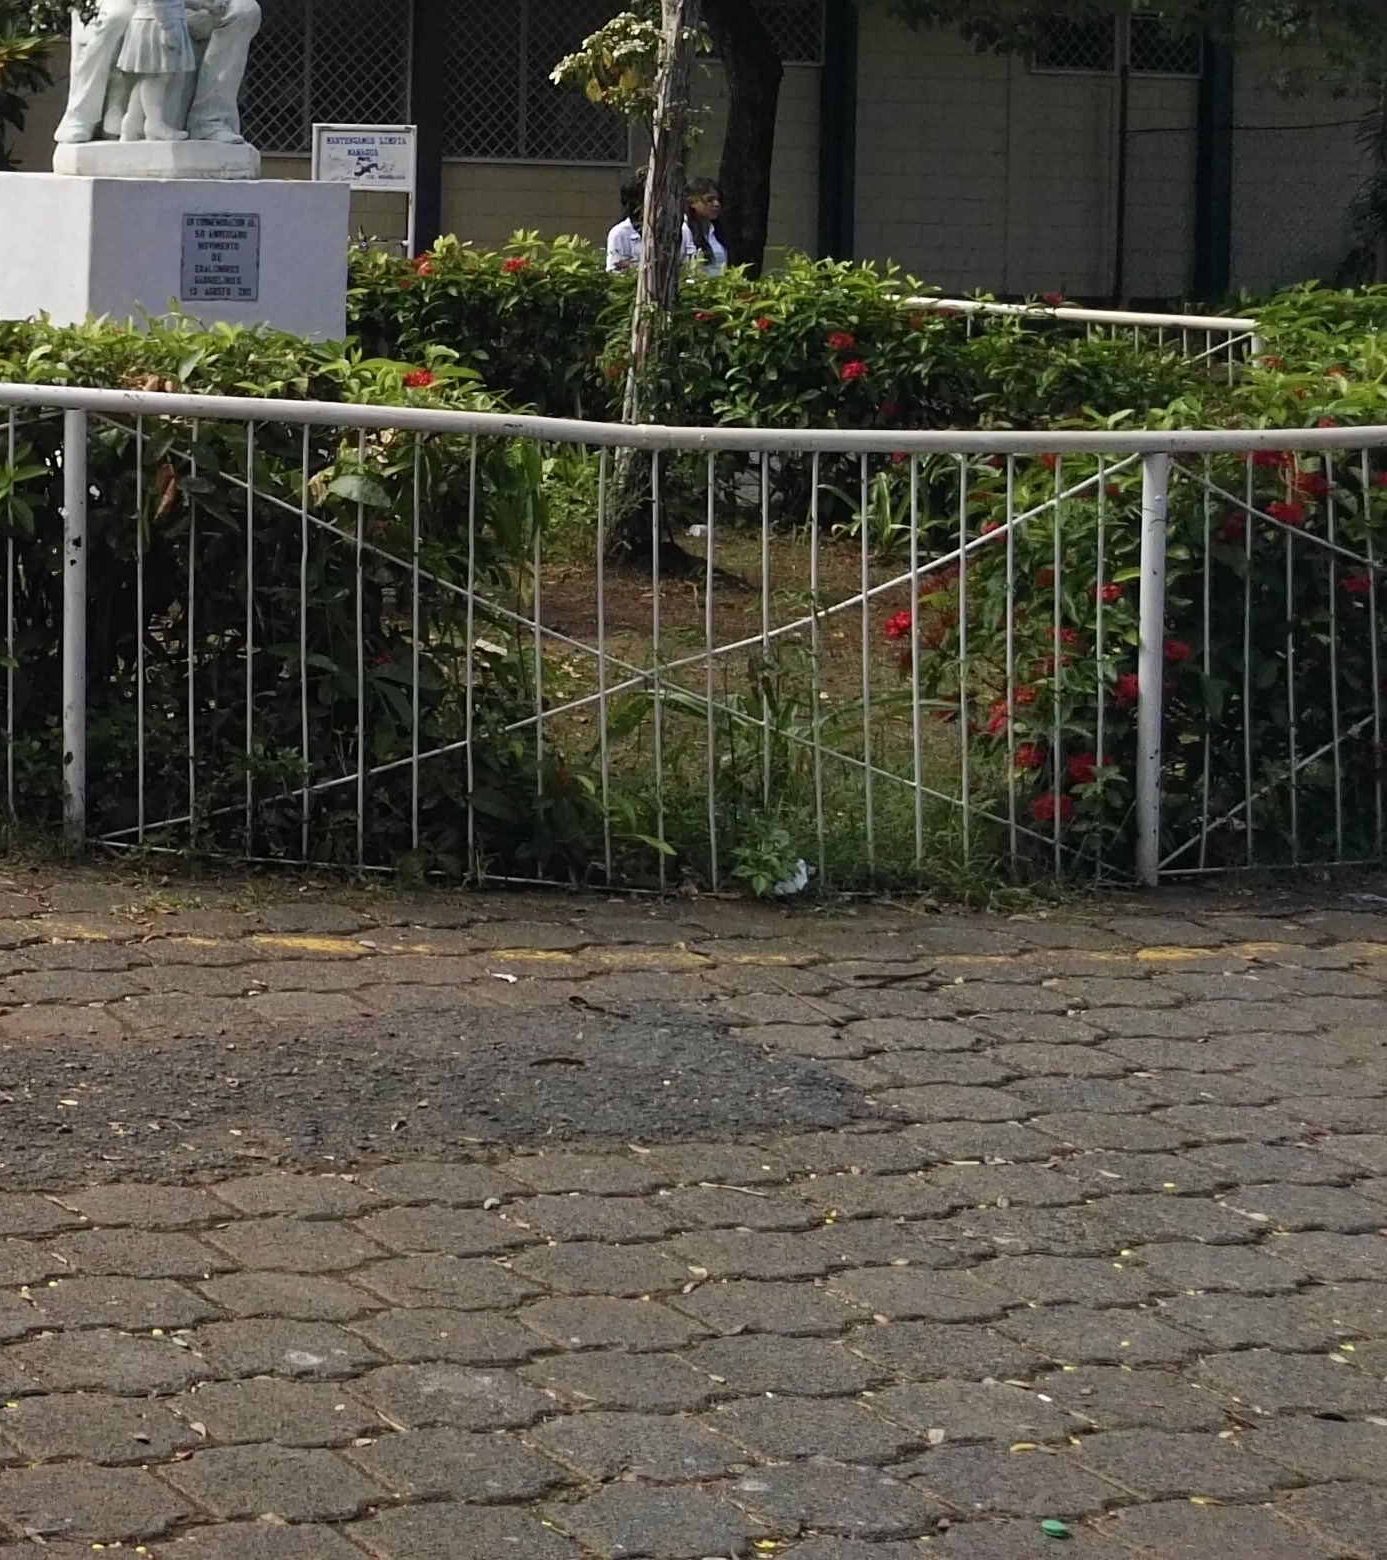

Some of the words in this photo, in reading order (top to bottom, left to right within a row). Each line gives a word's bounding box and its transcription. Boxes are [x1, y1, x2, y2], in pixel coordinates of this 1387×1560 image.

[326, 136, 376, 145] MANTENGAMOS
[379, 136, 407, 145] LIMPIA
[347, 148, 379, 157] MANAGUA
[197, 242, 239, 250] MOVIMIENTO
[211, 253, 222, 262] DE
[204, 287, 231, 296] AGOSTO
